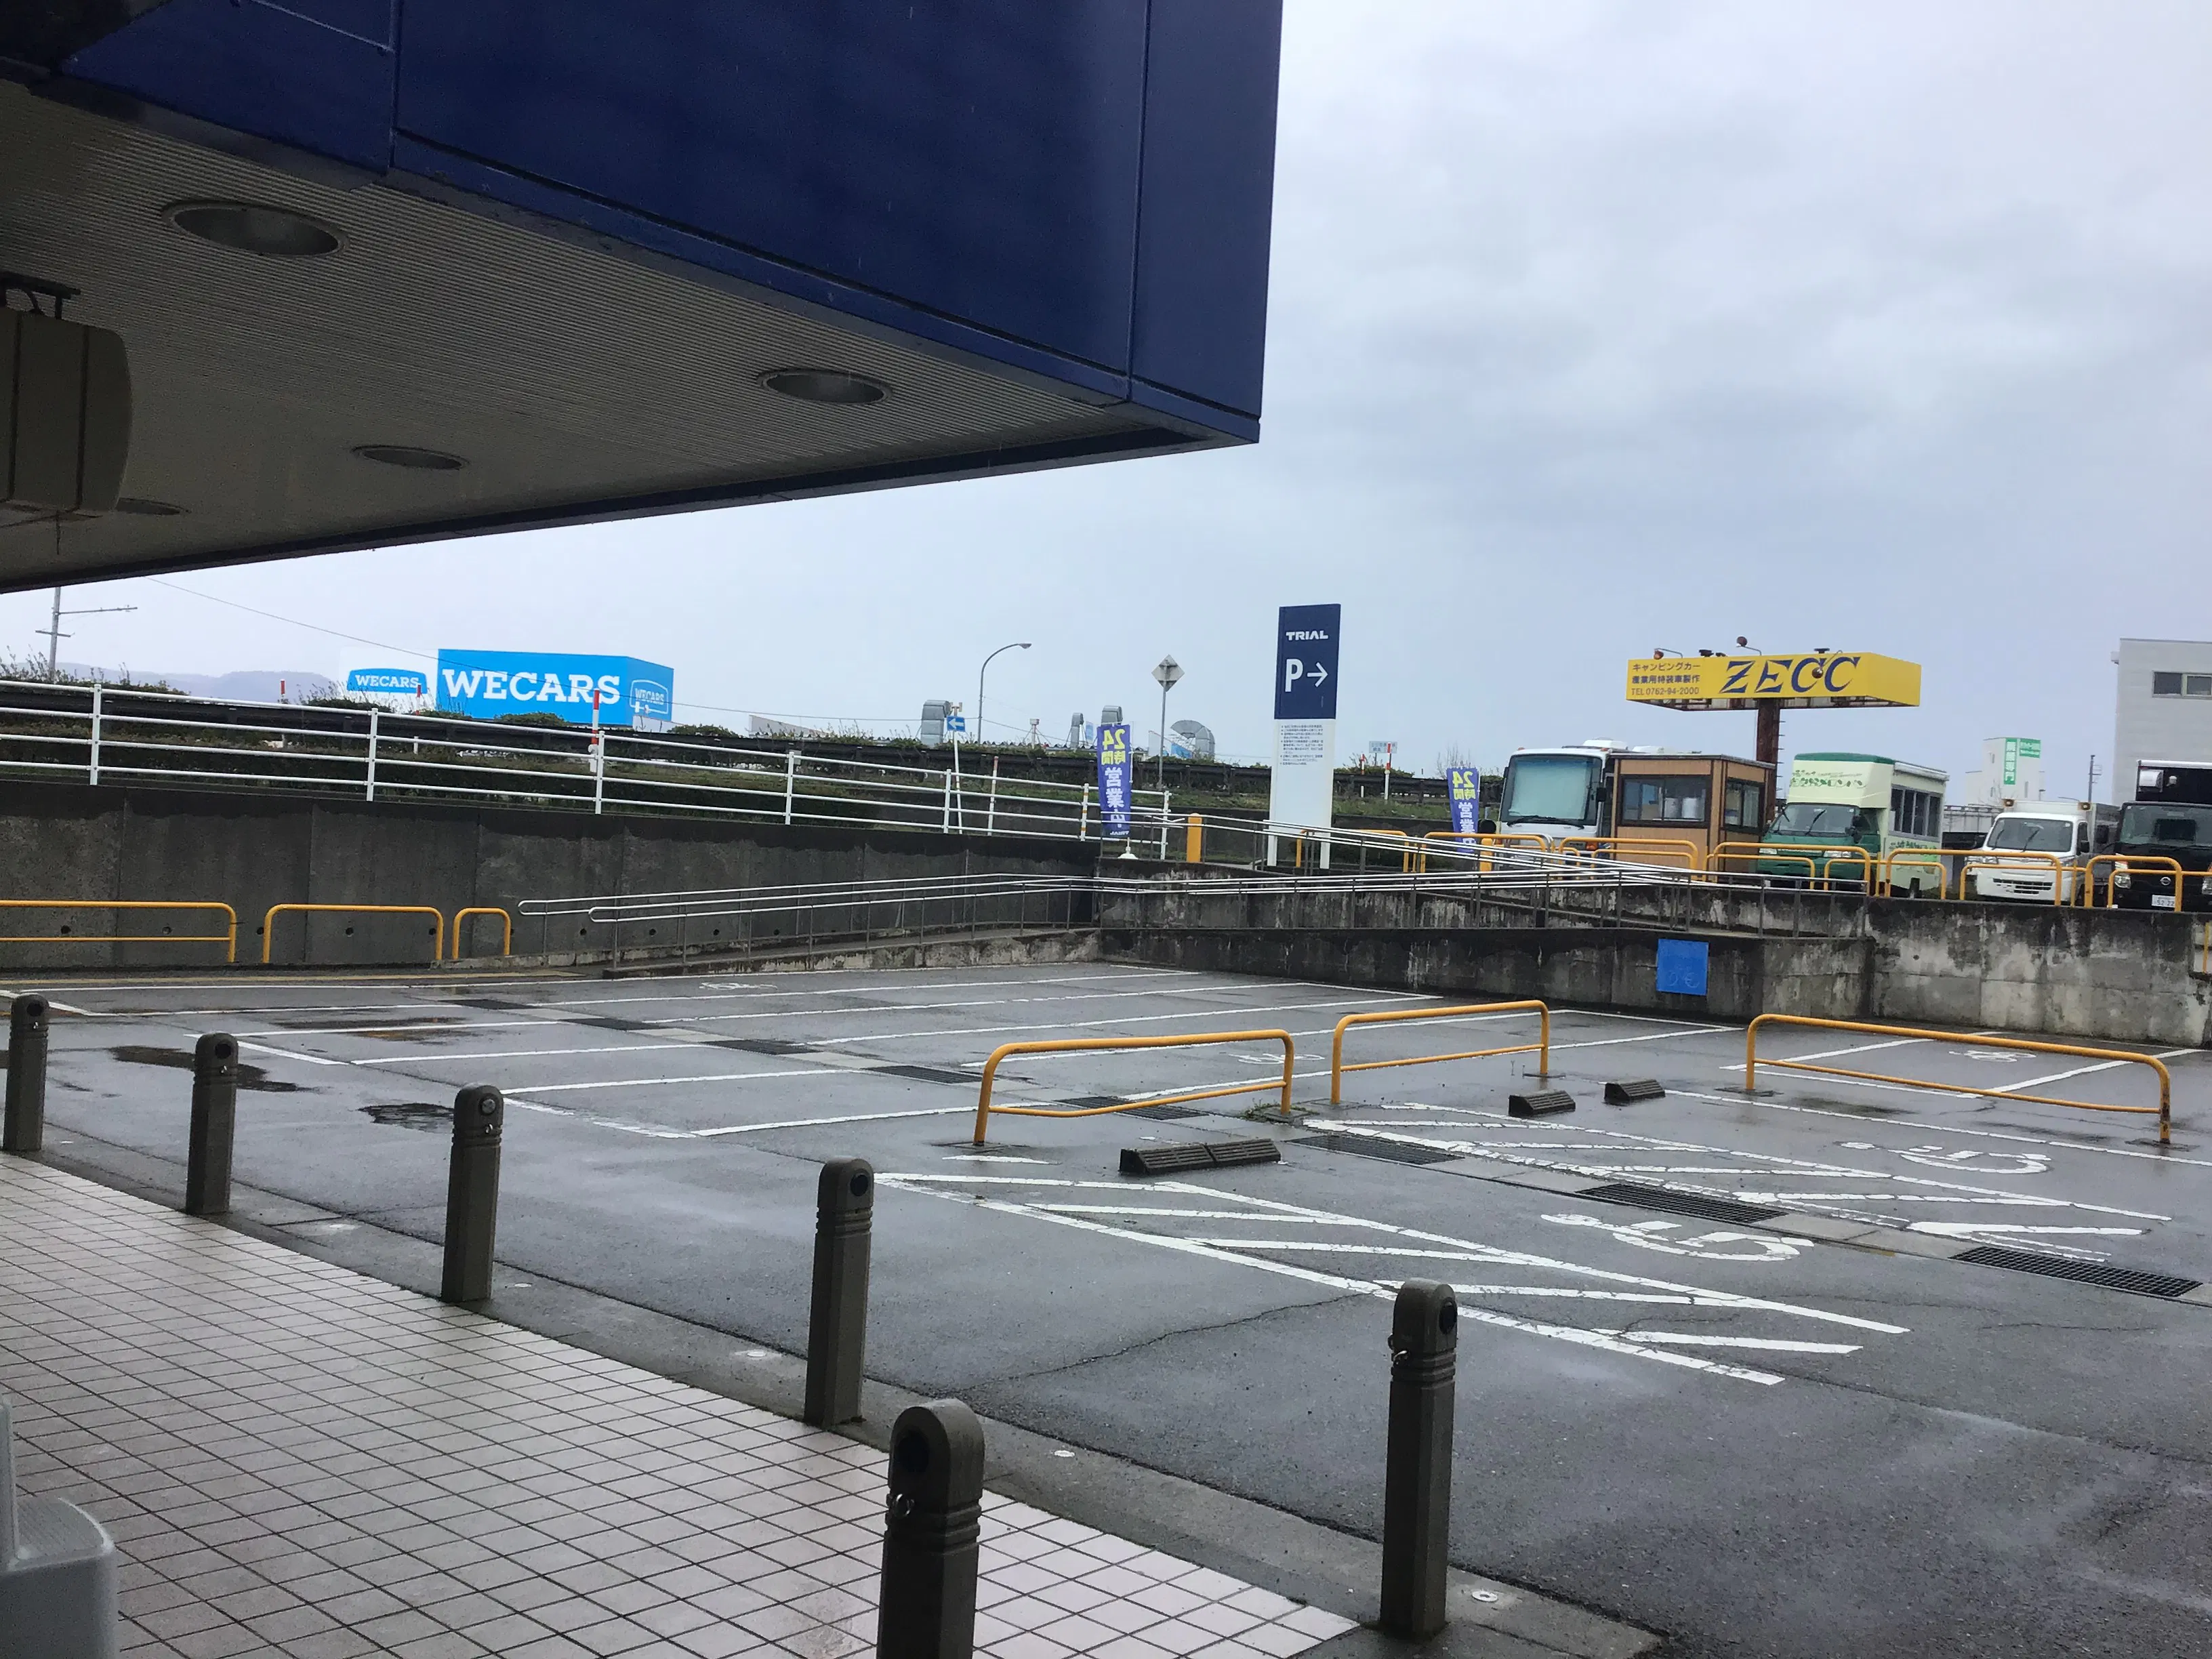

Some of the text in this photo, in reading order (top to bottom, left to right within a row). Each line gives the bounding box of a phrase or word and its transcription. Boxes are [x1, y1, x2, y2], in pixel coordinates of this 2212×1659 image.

[1286, 630, 1329, 641] TRIAL
[354, 674, 419, 689] WECARS
[442, 668, 620, 704] WECARS
[1285, 658, 1304, 692] P
[1719, 656, 1861, 693] ZECC
[634, 688, 665, 705] WECARS
